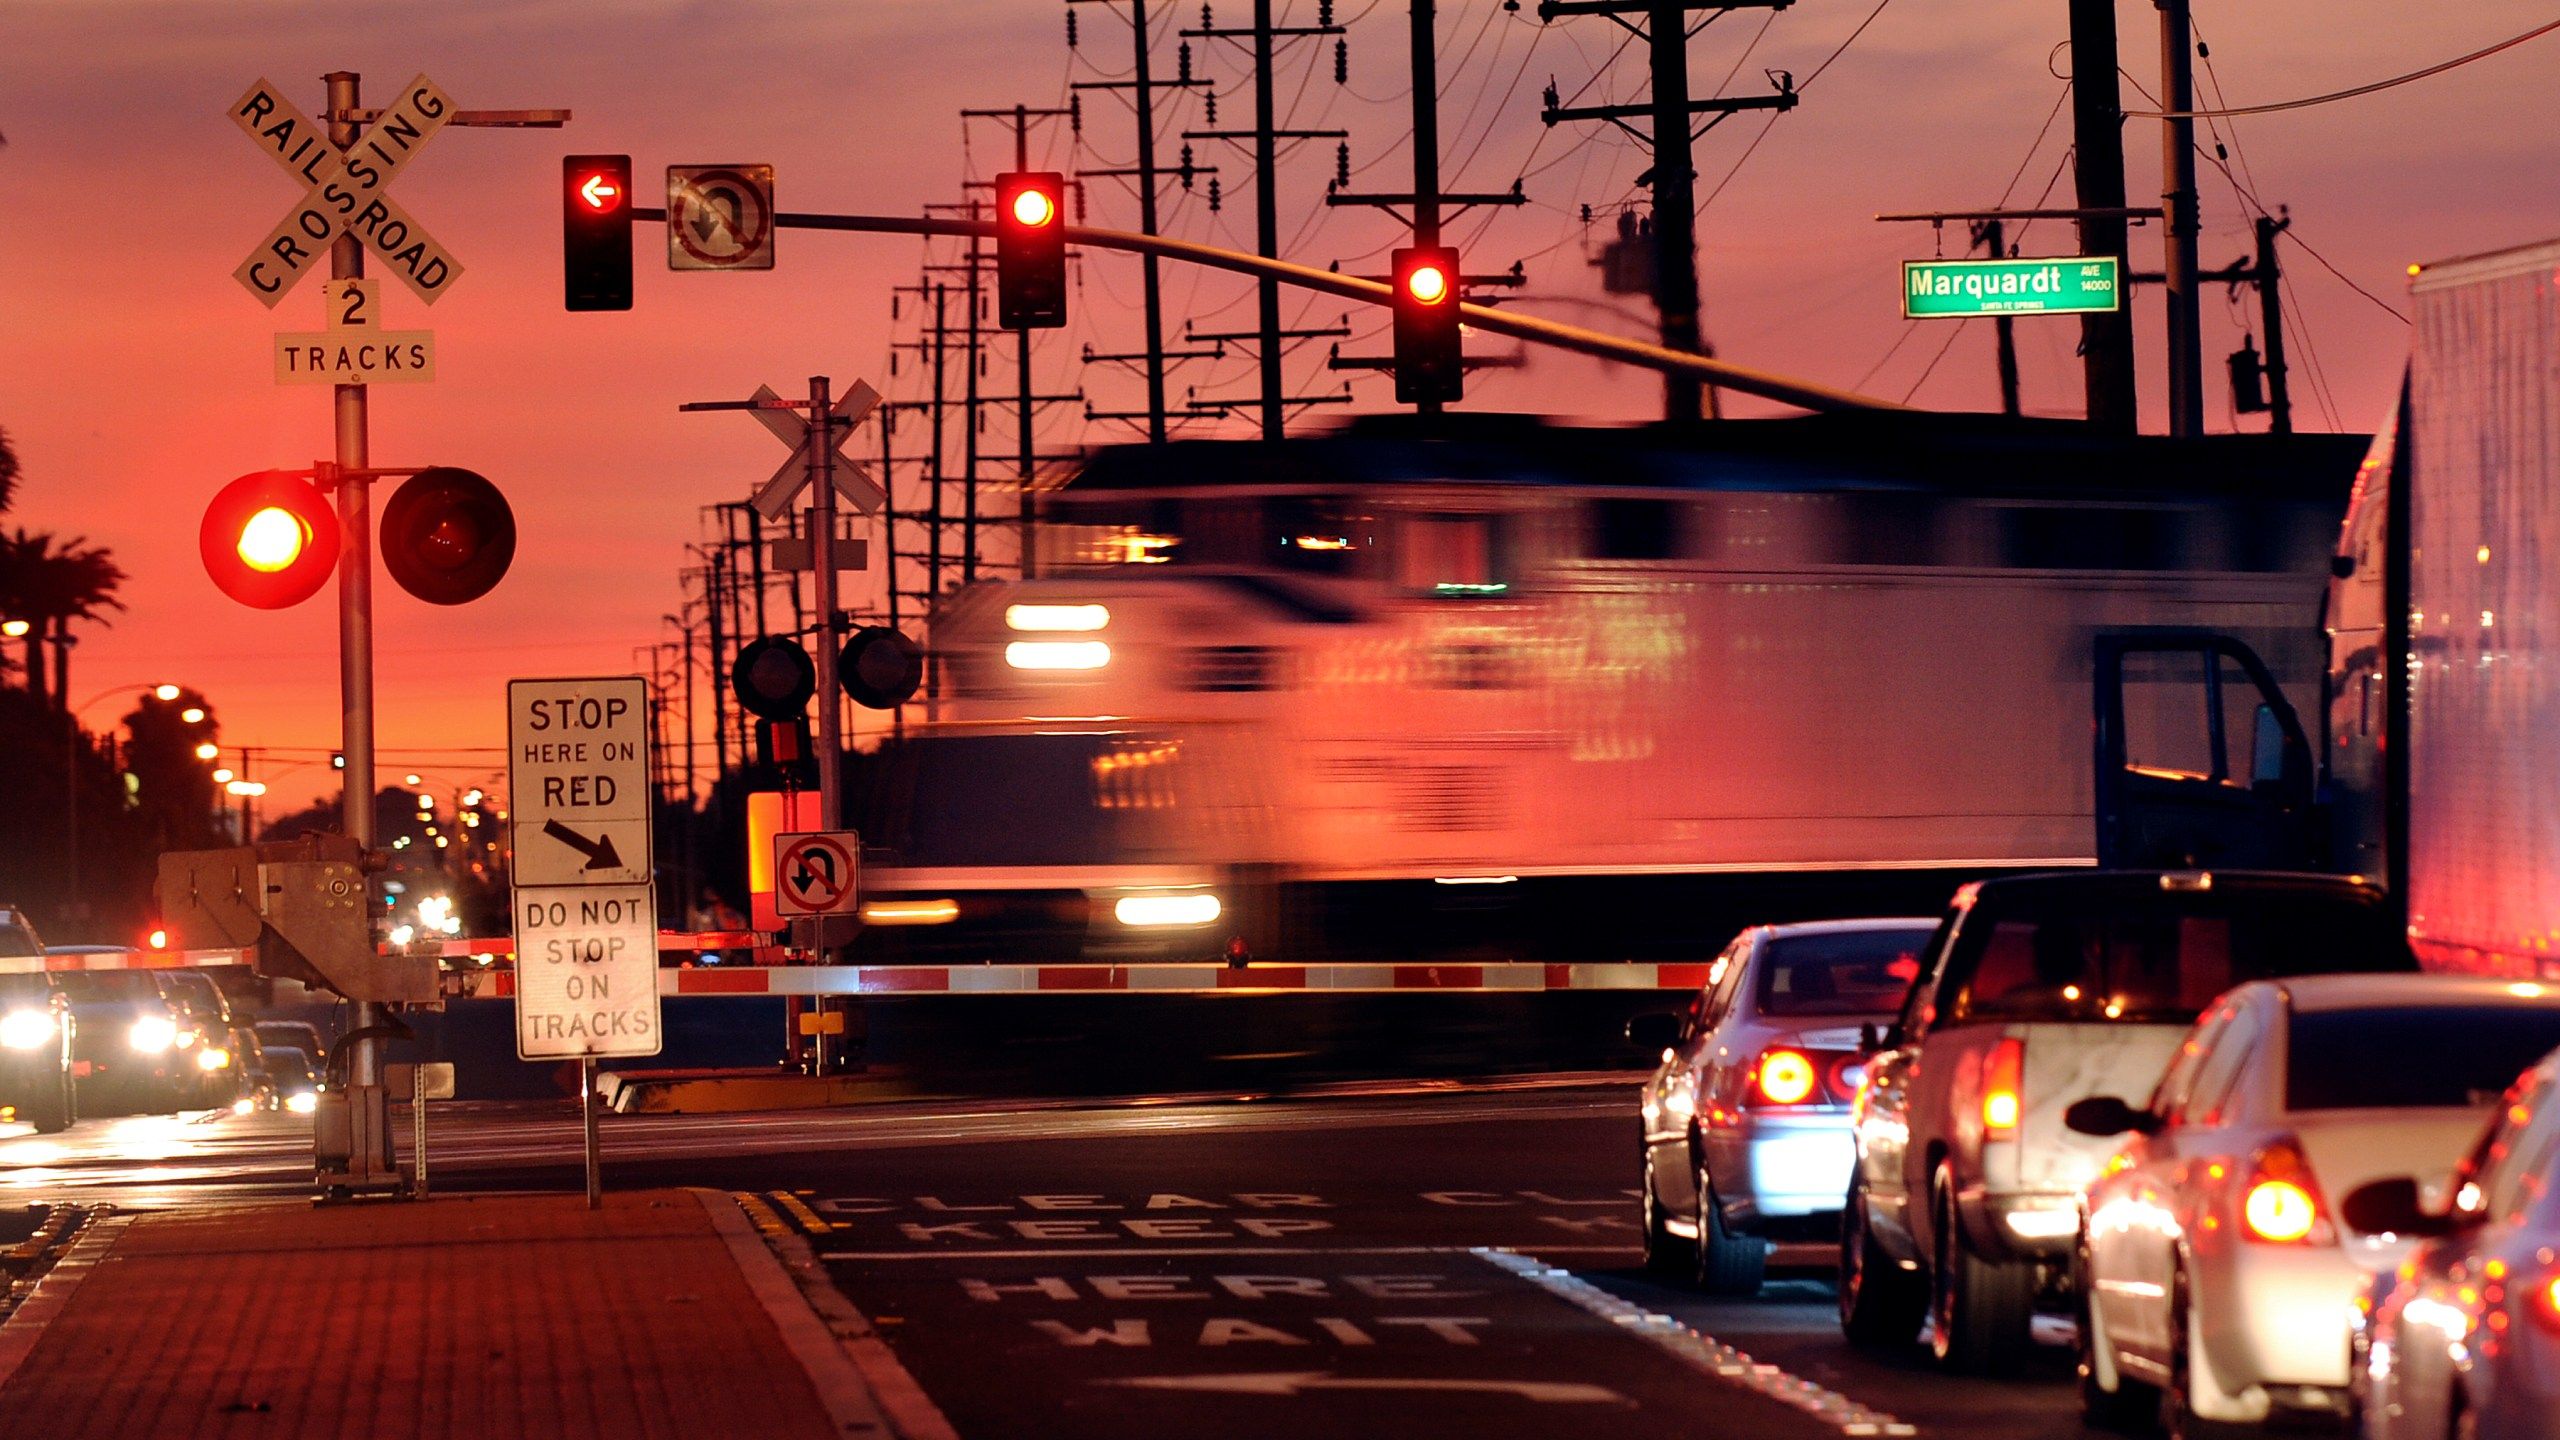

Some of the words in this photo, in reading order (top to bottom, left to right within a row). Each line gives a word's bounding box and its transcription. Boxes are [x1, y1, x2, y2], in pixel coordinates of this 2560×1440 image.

[249, 88, 444, 294] CROSSING
[1910, 266, 2061, 299] Marquardt
[2080, 264, 2101, 277] AVE
[2080, 279, 2112, 292] 14000
[341, 289, 367, 325] 2
[284, 344, 426, 371] TRACKS
[529, 697, 628, 731] STOP
[524, 742, 588, 763] HERE
[602, 742, 634, 762] ON
[543, 775, 617, 808] RED
[527, 902, 567, 929] DO
[581, 898, 641, 926] NOT
[546, 936, 627, 965] STOP
[566, 974, 609, 1001] ON
[528, 1009, 650, 1040] TRACKS
[814, 1193, 1338, 1213] CLEAR
[900, 1218, 1336, 1241] KEEP
[957, 1273, 1487, 1301] HERE
[1028, 1317, 1491, 1347] WAIT
